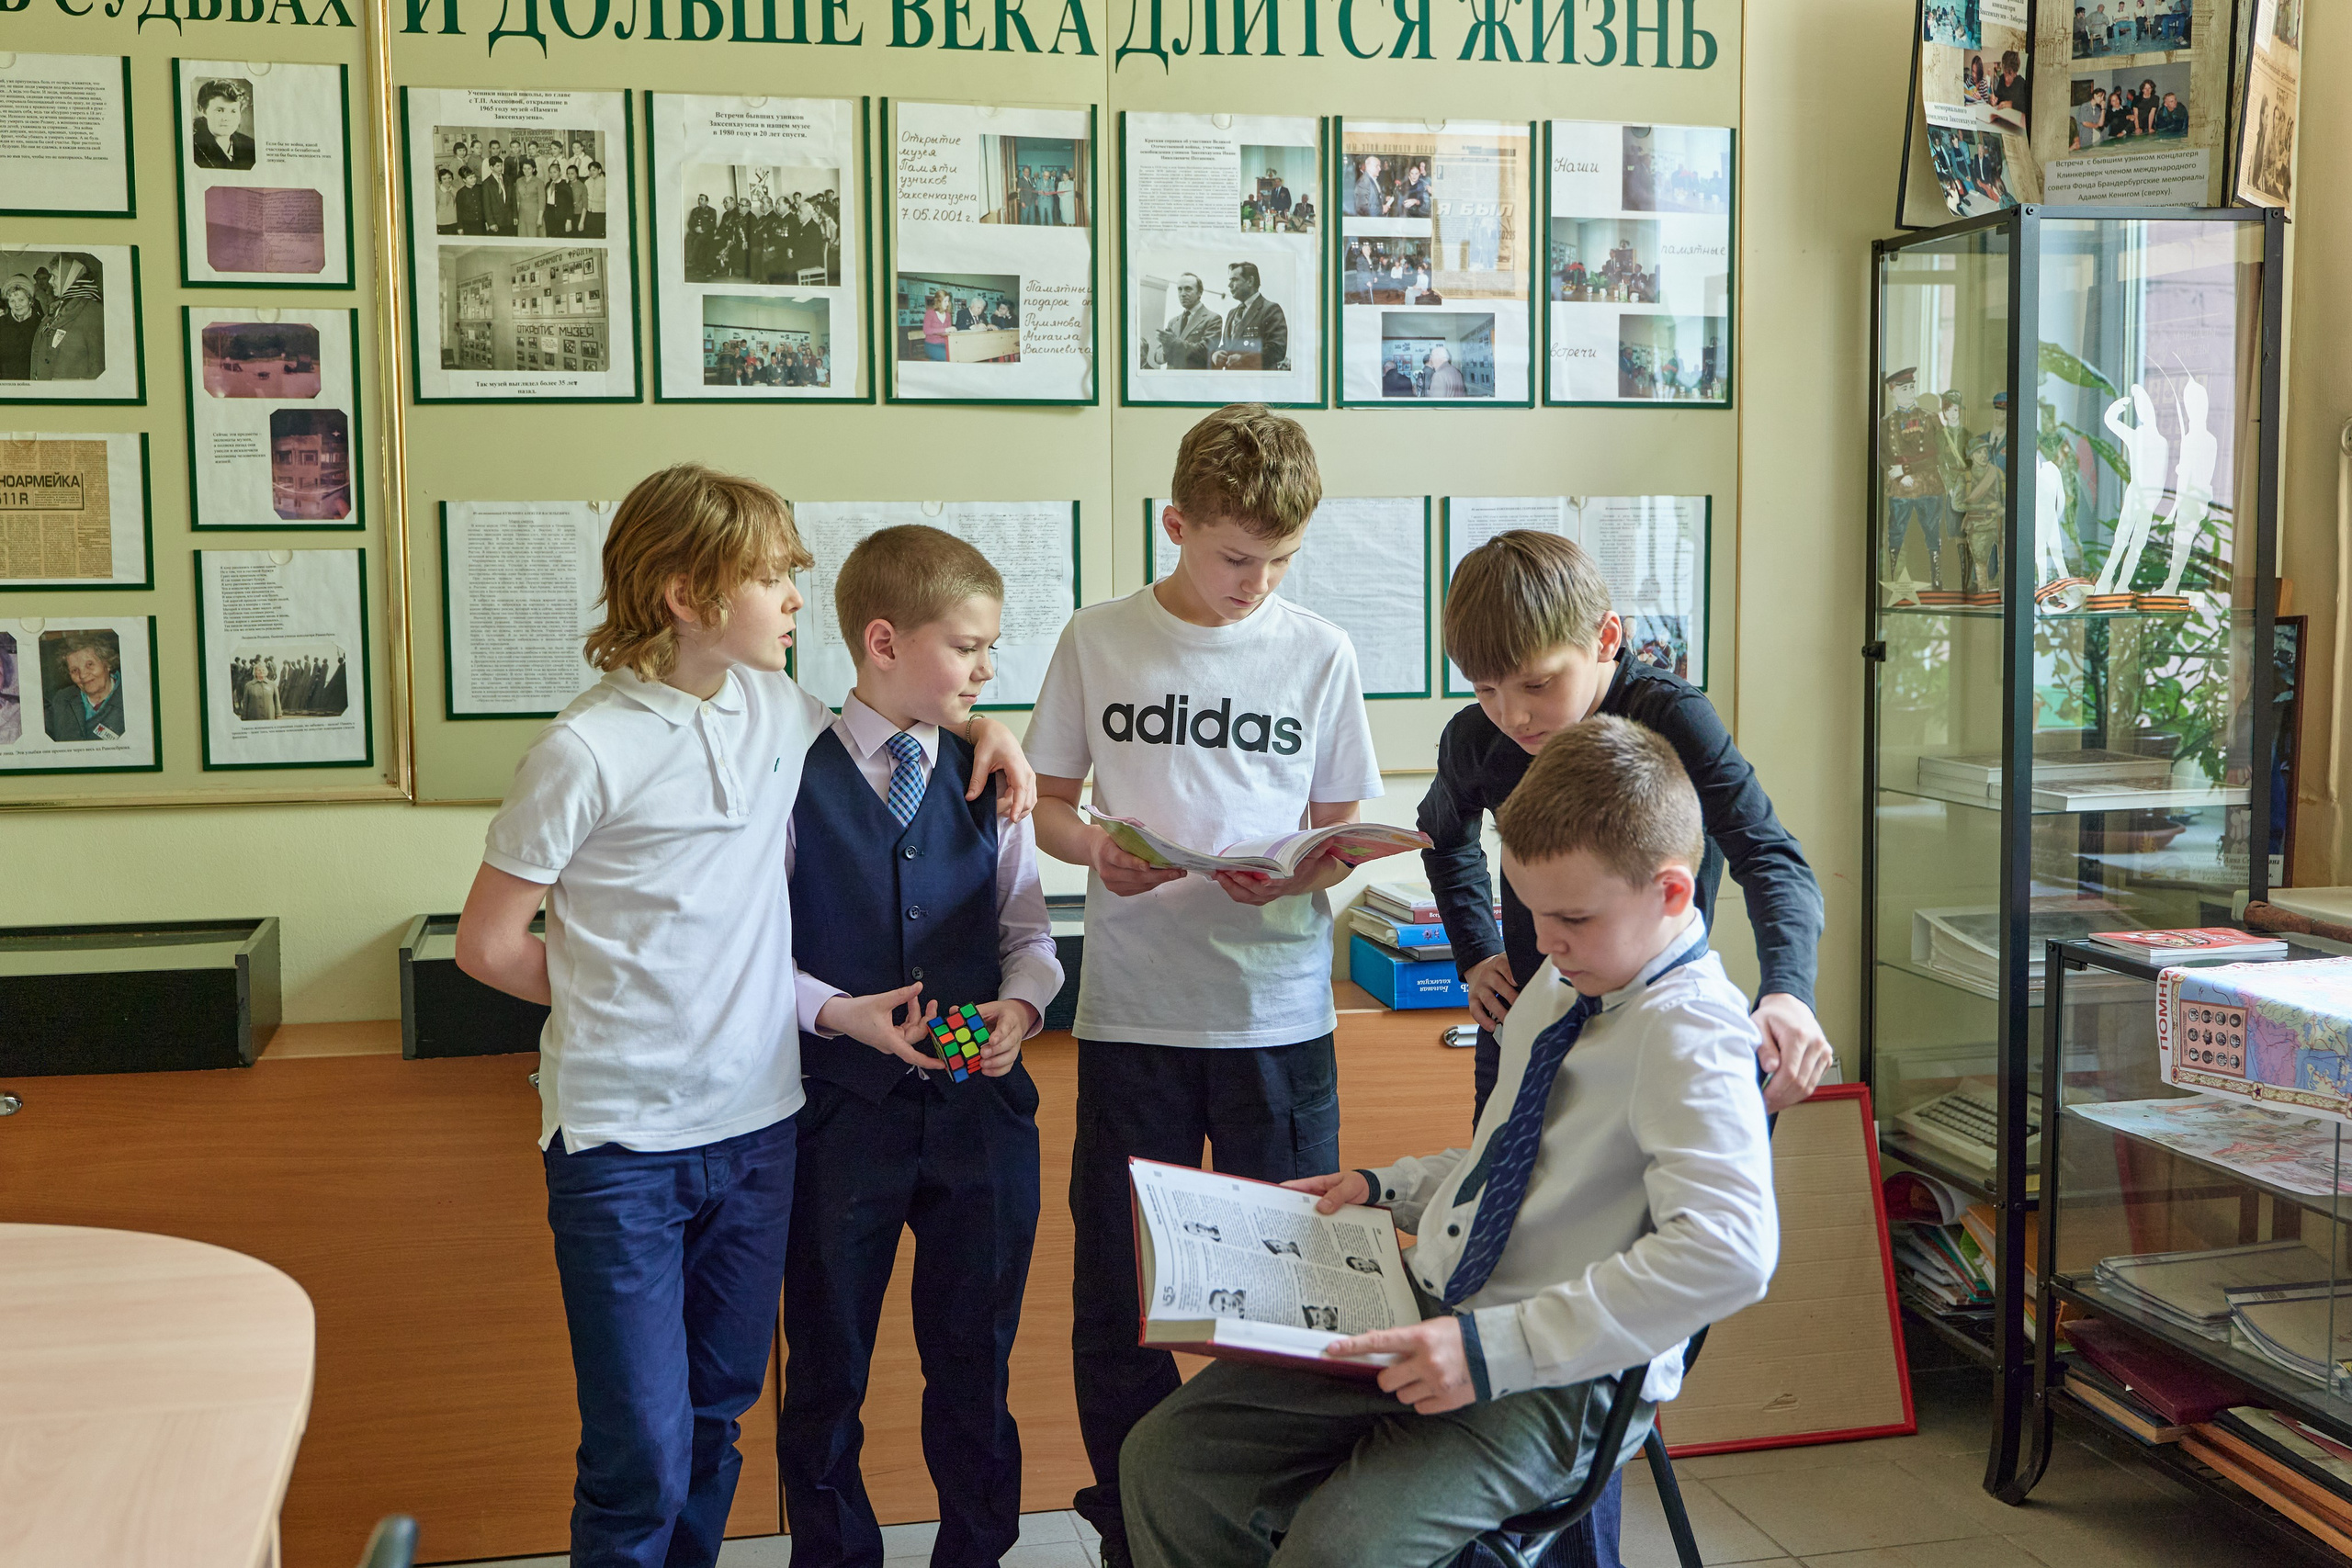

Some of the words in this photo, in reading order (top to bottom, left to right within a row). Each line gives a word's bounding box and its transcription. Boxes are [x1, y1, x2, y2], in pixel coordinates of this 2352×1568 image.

[886, 0, 1100, 56] ВЕКА
[1115, 0, 1437, 75] ДЛИТСЯ
[1456, 0, 1718, 70] ЖИЗНЬ
[709, 120, 759, 129] Заксенхаузена
[901, 130, 961, 146] Открытие
[899, 148, 936, 160] музея
[2156, 151, 2199, 160] концлагеря
[899, 158, 957, 173] Памяти
[1554, 156, 1600, 173] Наши
[2057, 169, 2103, 178] Клинкерверк
[2104, 167, 2132, 175] членом
[2133, 163, 2197, 173] международного
[899, 175, 947, 187] узников
[2098, 177, 2160, 188] Брандербургские
[2161, 175, 2205, 183] мемориалы
[898, 188, 978, 205] Заксенхаузена
[2078, 193, 2108, 201] Адамом
[2142, 187, 2173, 197] (сверху).
[1437, 202, 1452, 216] Я
[1460, 203, 1514, 217] БЫЛ
[1661, 244, 1725, 255] памятные
[516, 264, 530, 273] БОЙЦЫ
[534, 254, 562, 268] НЕЗРИМОГО
[568, 248, 594, 258] ФРОНТА
[1023, 299, 1069, 311] подарок
[1024, 312, 1081, 331] Румянова
[517, 325, 554, 335] ОТКРЫТИЕ
[559, 326, 594, 338] МУЗЕЯ
[1023, 330, 1080, 341] Михаила
[1023, 344, 1092, 355] Васильевича
[1550, 342, 1597, 361] встречи
[1102, 694, 1303, 756] adidas
[2158, 970, 2175, 1051] ПОМНИ
